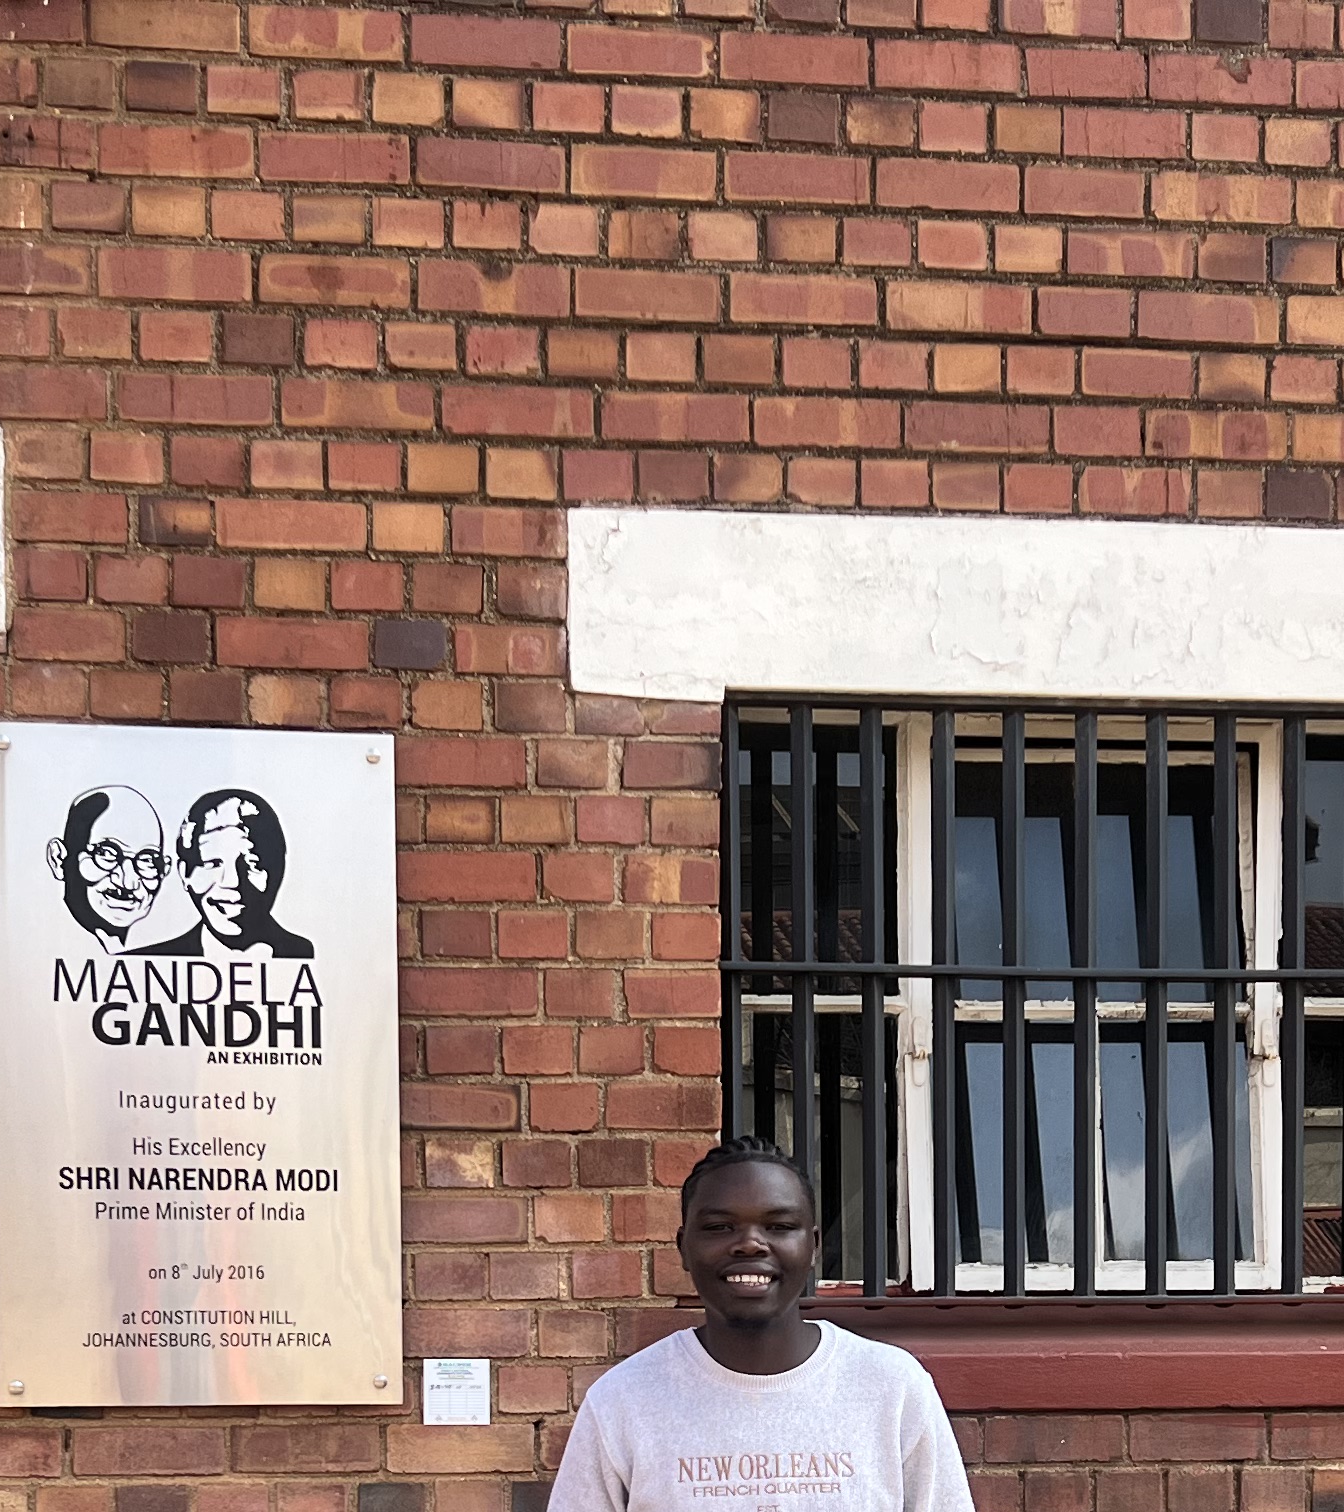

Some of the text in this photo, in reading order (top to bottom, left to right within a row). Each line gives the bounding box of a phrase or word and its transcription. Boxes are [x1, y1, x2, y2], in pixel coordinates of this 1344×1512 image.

[53, 958, 323, 1007] MANDELA
[92, 1001, 322, 1049] GANDHI
[207, 1052, 322, 1066] AN EXHIBITION
[119, 1090, 276, 1115] Inaugurated by
[133, 1137, 267, 1161] His Excellency
[58, 1166, 339, 1192] SHRI NARENDRA MODI
[95, 1201, 306, 1221] Prime Minister of India
[148, 1268, 167, 1280] on
[193, 1265, 223, 1283] July
[228, 1265, 265, 1280] 2016
[122, 1310, 297, 1327] at CONSTITUTION HILL,
[83, 1332, 332, 1349] JOHANNESBURG, SOUTH AFRICA
[677, 1452, 856, 1483] NEW ORLEANS
[693, 1482, 842, 1498] FRENCH QUARTER
